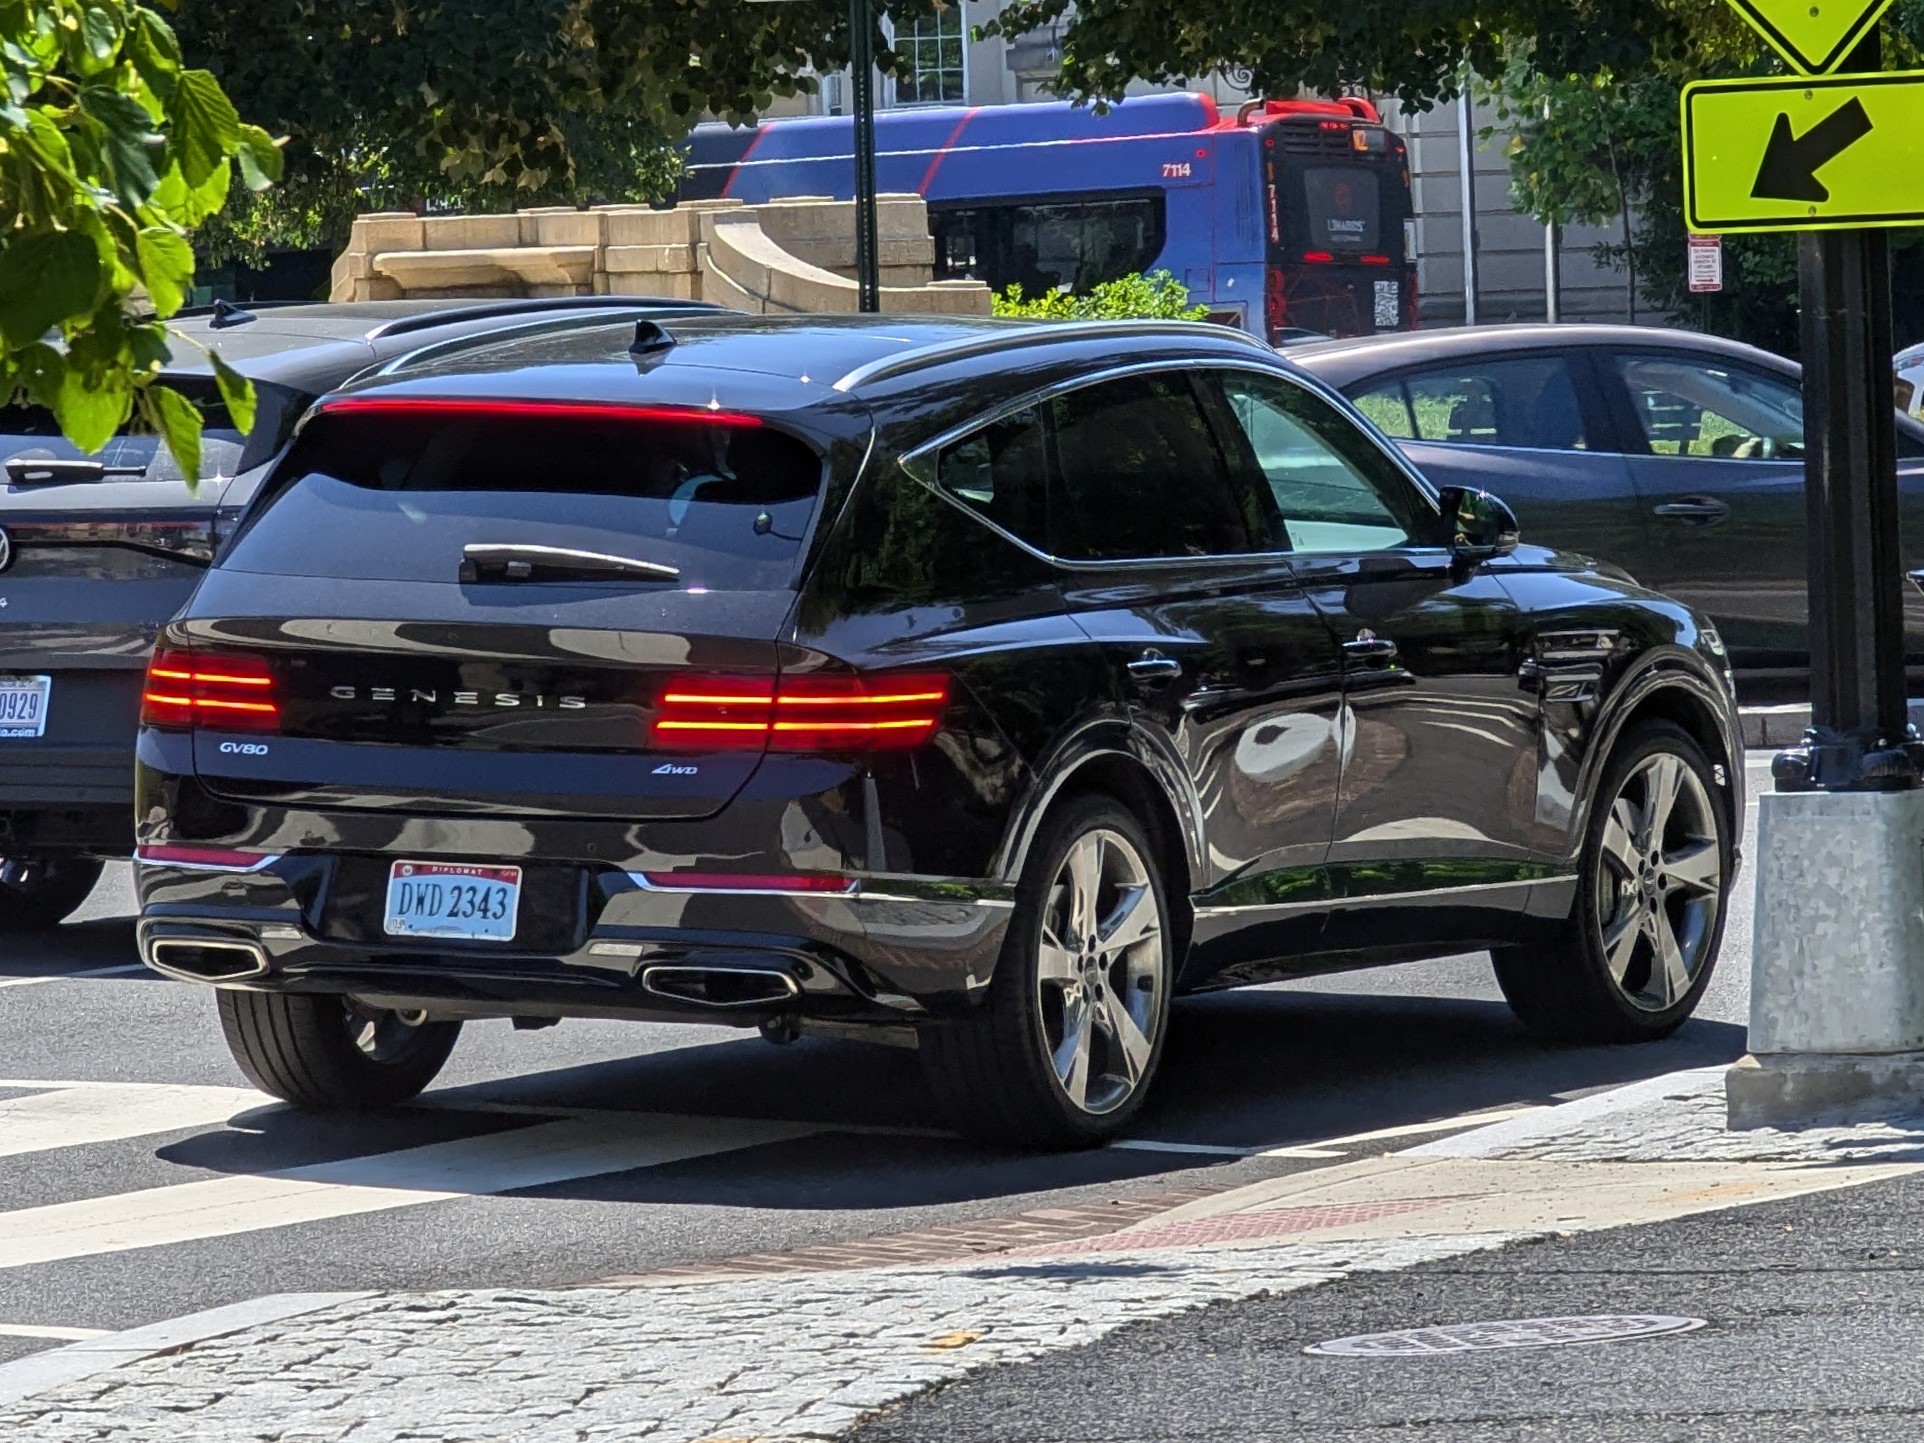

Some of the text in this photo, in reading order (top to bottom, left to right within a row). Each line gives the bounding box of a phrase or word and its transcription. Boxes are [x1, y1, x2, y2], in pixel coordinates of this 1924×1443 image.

[1162, 162, 1192, 177] 7114
[1267, 183, 1279, 242] 7114
[329, 685, 586, 708] GENESIS
[0, 692, 38, 719] 0929
[0, 728, 35, 737] o.com
[220, 742, 269, 755] GV80
[651, 763, 698, 774] 4WD
[431, 865, 483, 876] DIPLOMAT
[398, 882, 508, 920] DWD 2343
